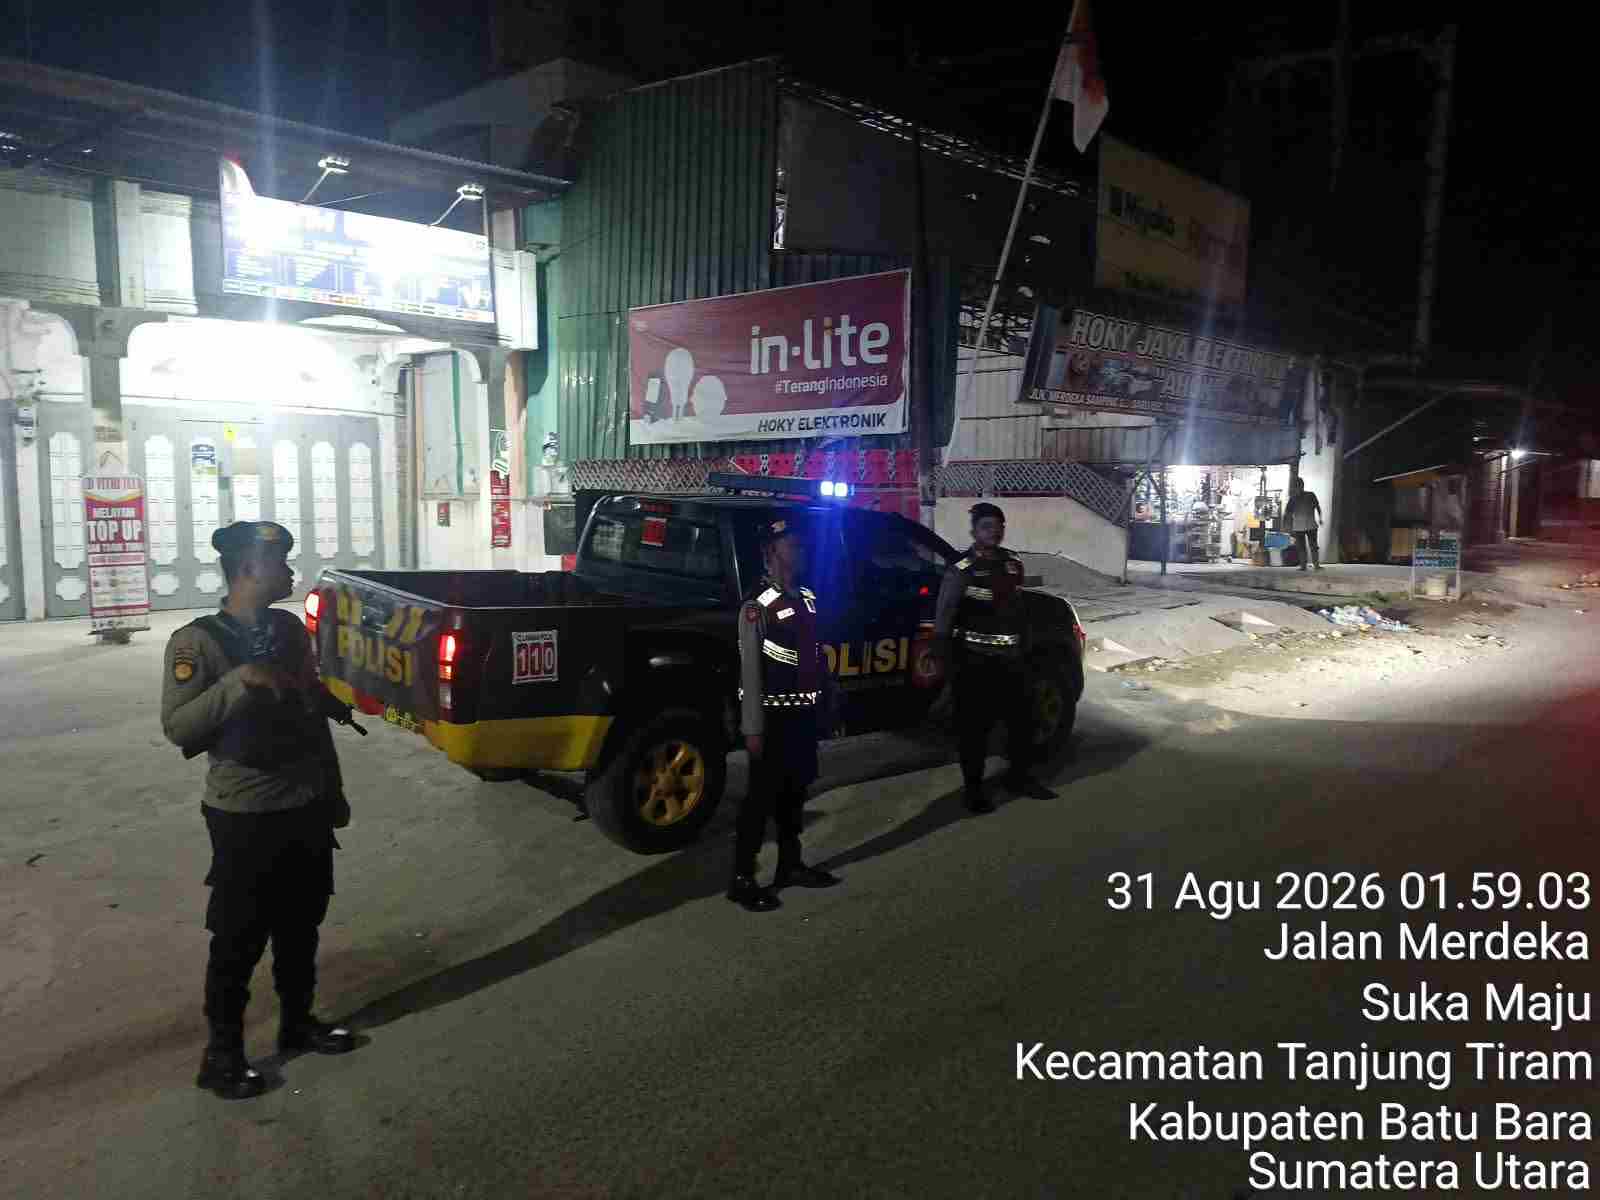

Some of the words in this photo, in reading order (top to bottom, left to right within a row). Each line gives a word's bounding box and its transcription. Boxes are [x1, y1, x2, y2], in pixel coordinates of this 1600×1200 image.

[1069, 312, 1138, 352] HOKY
[776, 374, 888, 394] #TerangIndonesia
[758, 418, 796, 433] HOKY
[798, 413, 886, 431] ELEKTRONIK
[87, 520, 119, 541] TOP
[122, 520, 142, 541] UP
[336, 623, 413, 687] POLISI
[520, 647, 554, 672] 110
